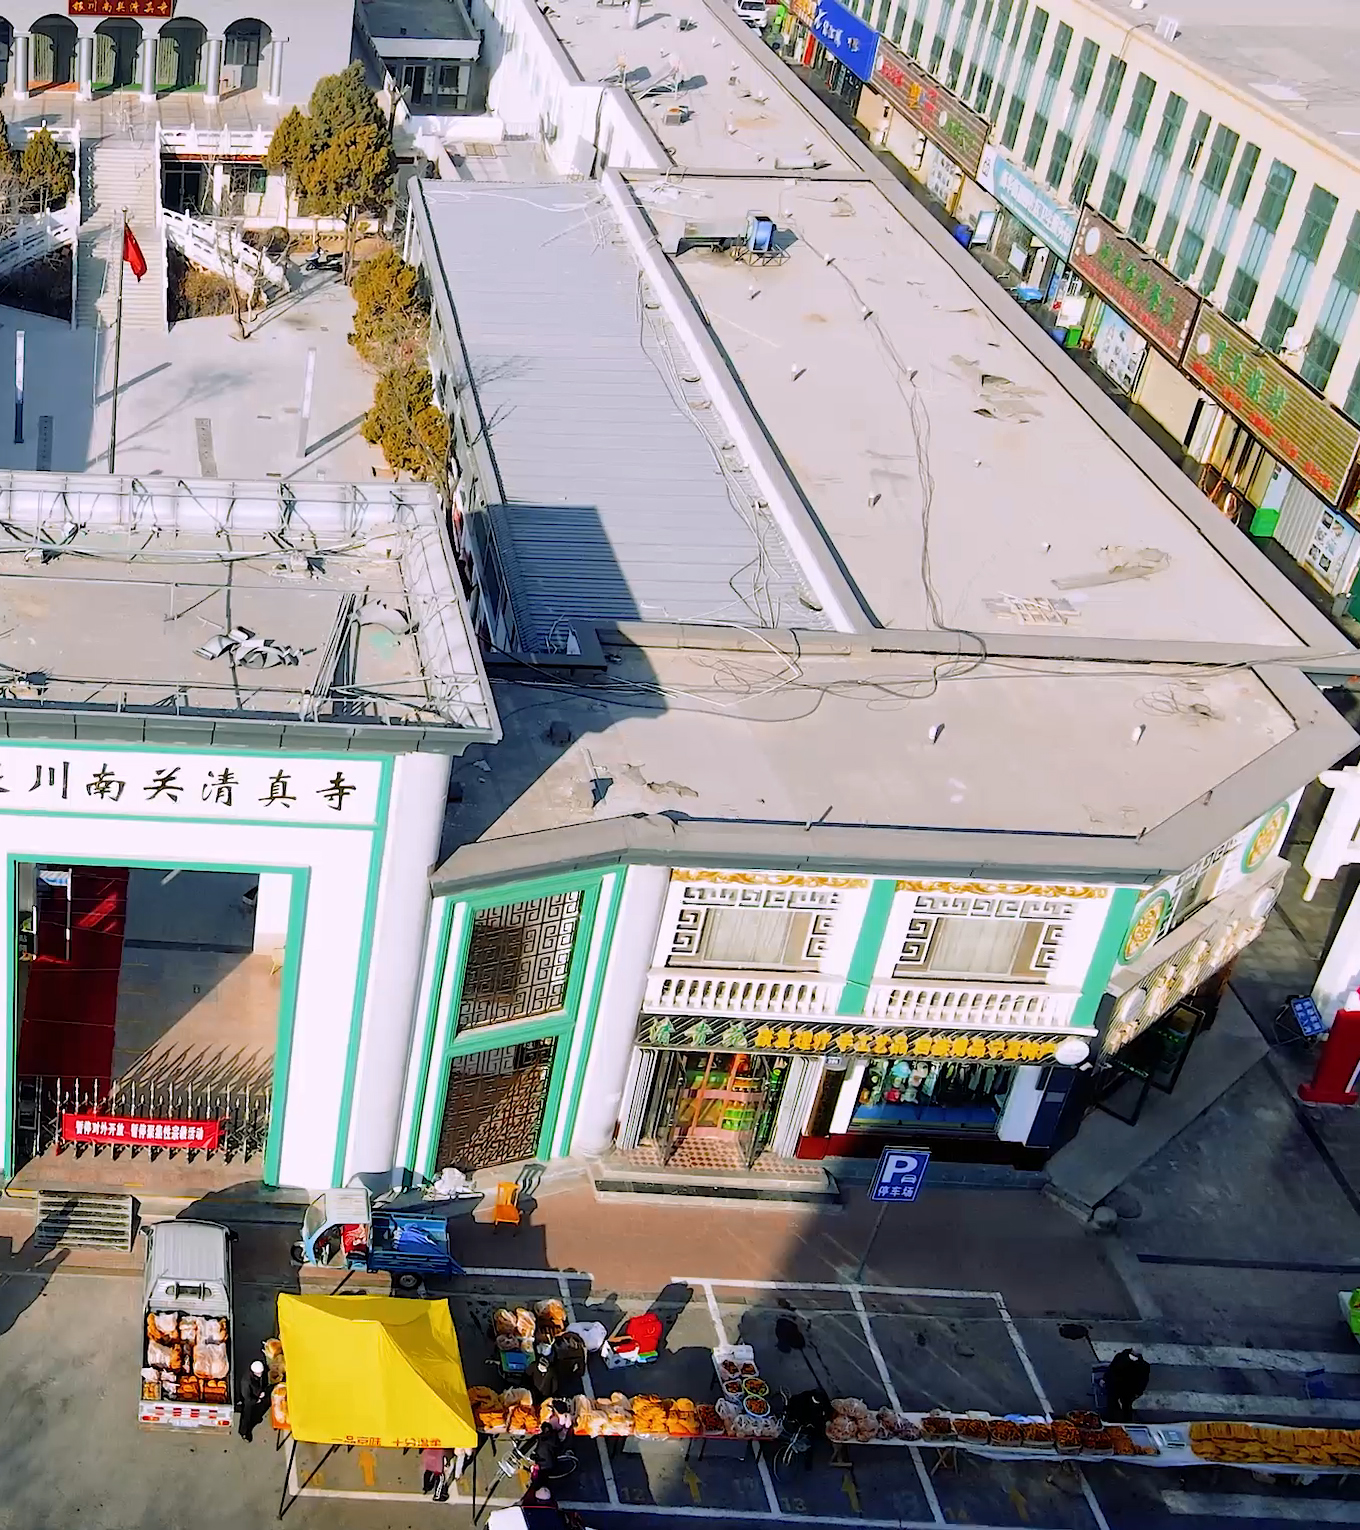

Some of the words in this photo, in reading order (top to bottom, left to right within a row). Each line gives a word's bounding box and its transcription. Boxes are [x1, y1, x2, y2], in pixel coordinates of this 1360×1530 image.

[881, 1155, 918, 1183] P
[878, 1185, 915, 1198] 停车场
